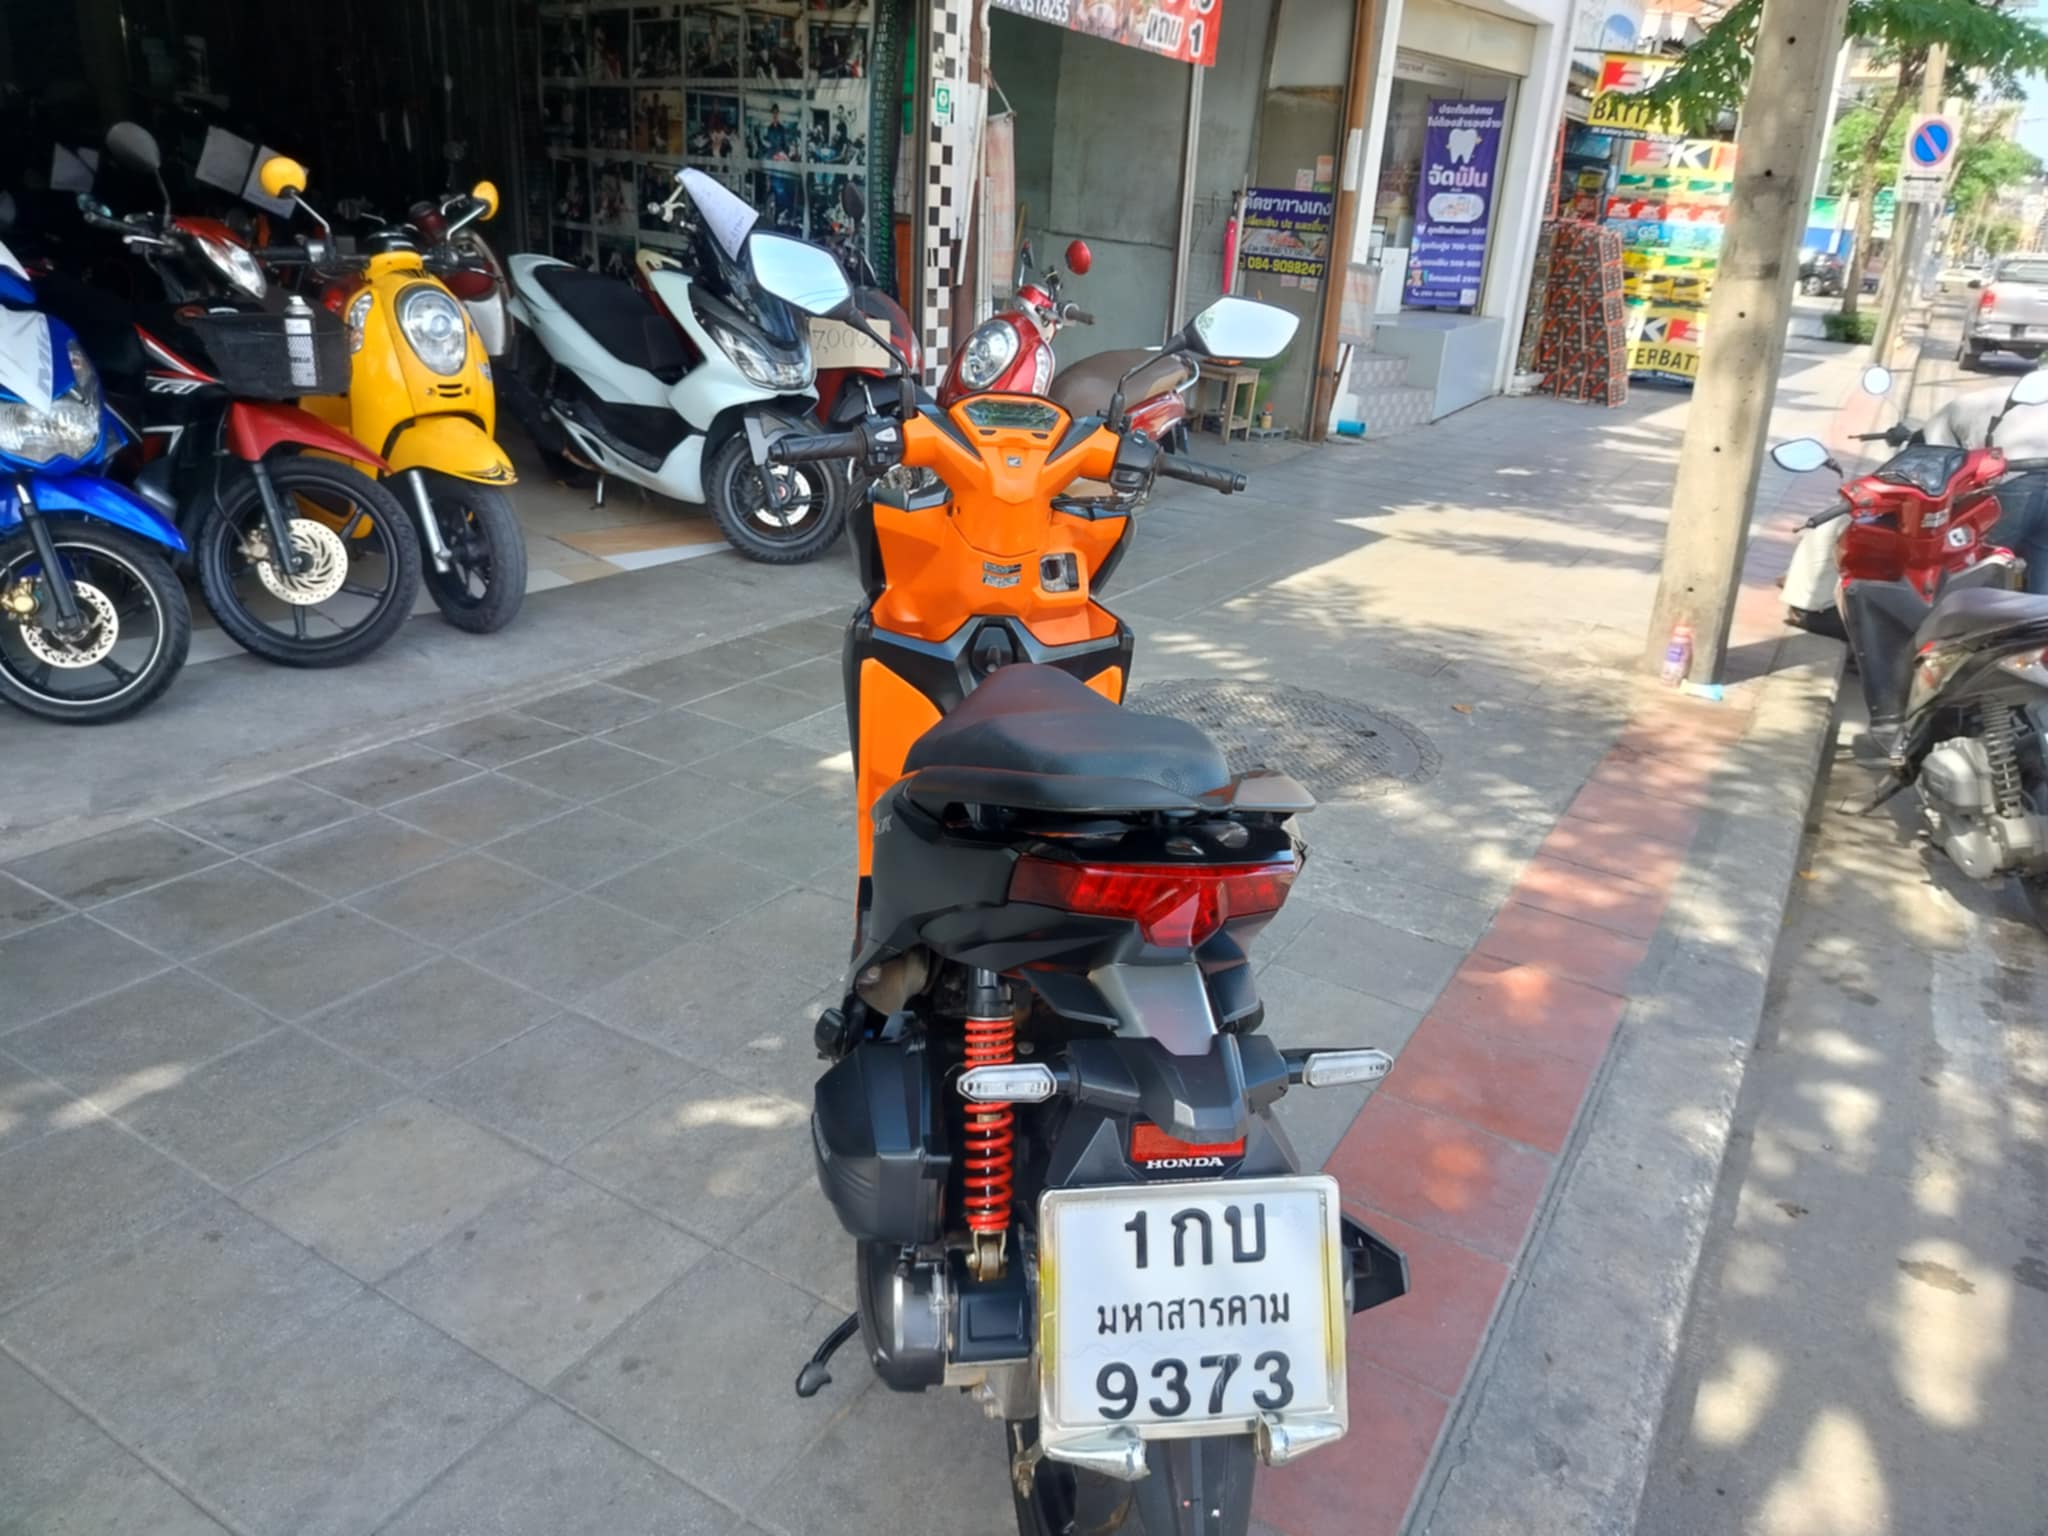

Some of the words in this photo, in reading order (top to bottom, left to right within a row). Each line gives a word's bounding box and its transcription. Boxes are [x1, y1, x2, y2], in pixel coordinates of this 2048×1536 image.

[1190, 21, 1203, 55] 1
[1427, 162, 1489, 188] จัดฟัน
[1146, 1156, 1225, 1170] HONDA
[1124, 1202, 1267, 1269] 1กบ
[1097, 1292, 1290, 1335] มหาสารคาม
[1095, 1350, 1295, 1420] 9373
